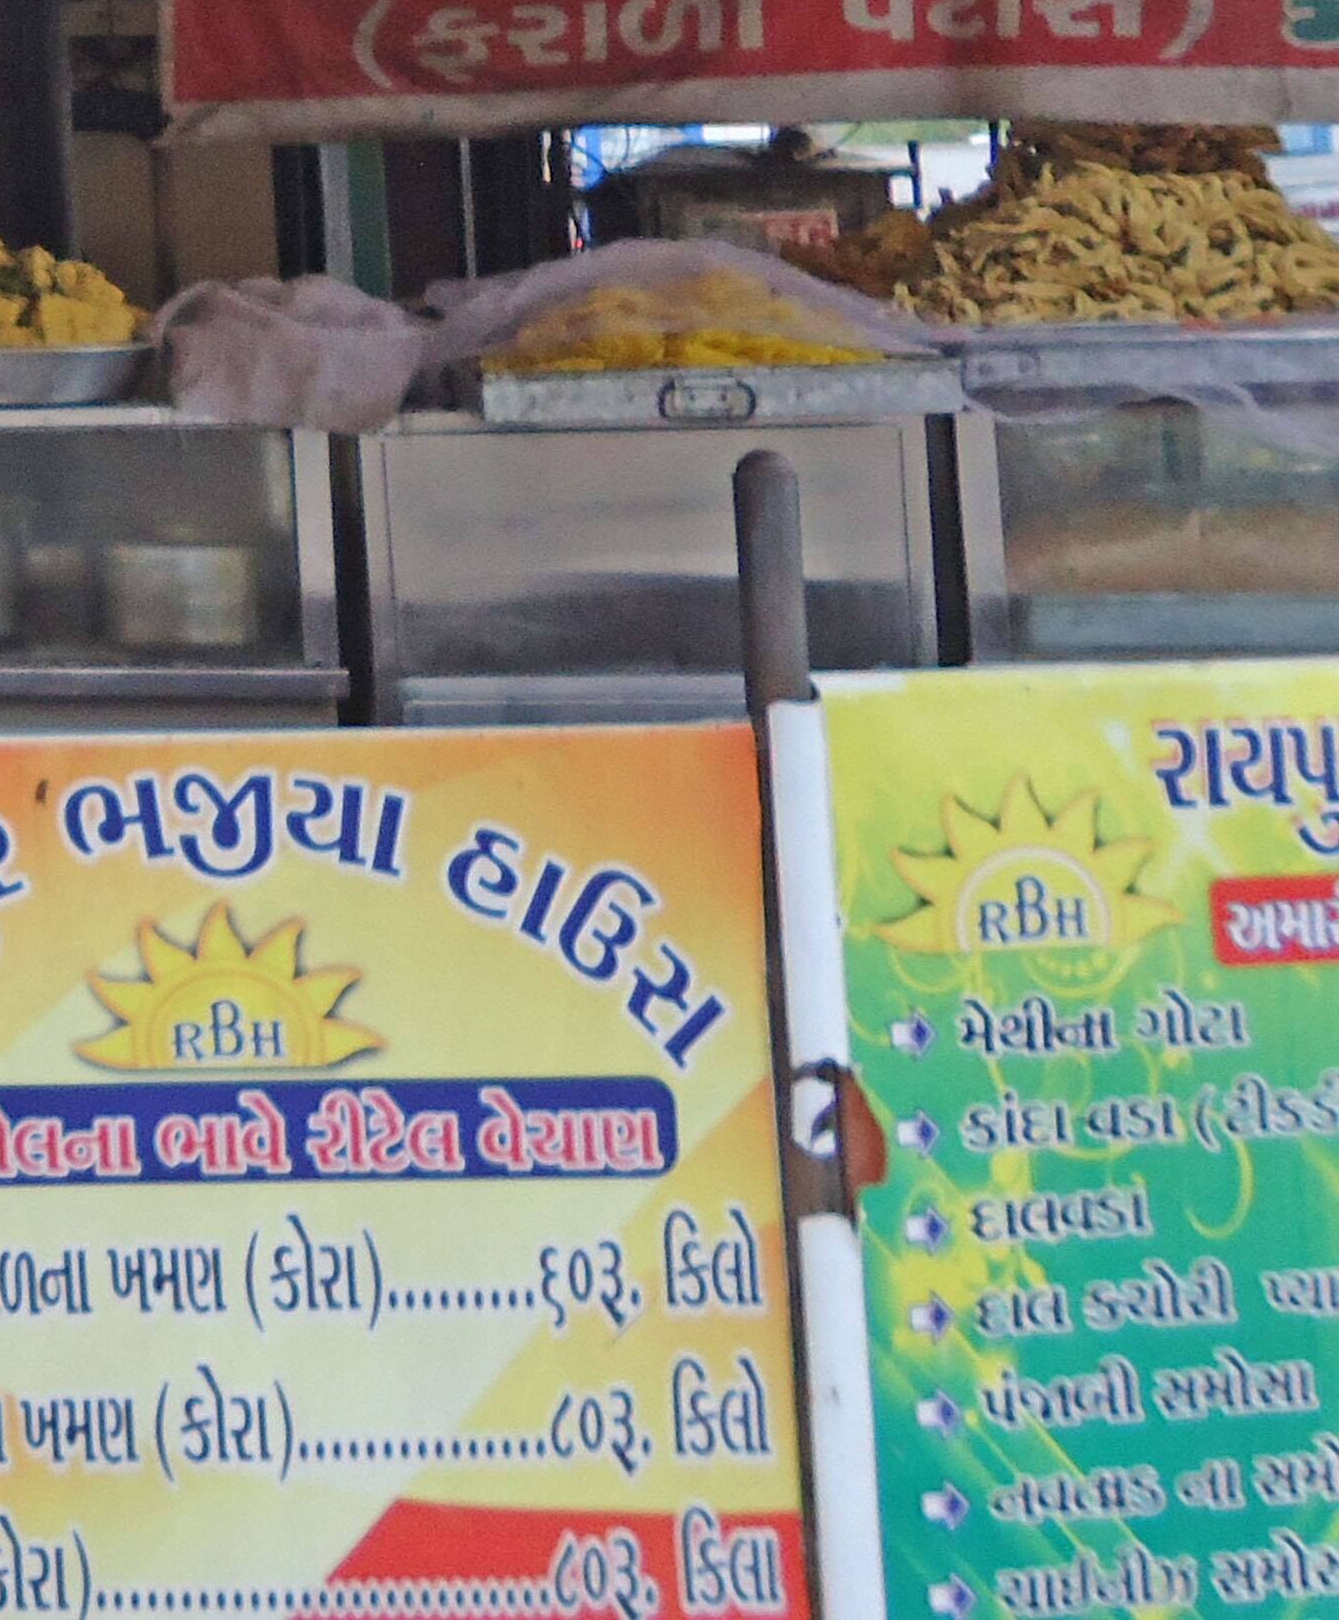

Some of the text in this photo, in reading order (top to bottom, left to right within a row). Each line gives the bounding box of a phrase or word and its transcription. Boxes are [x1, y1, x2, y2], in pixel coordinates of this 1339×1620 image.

[63, 771, 410, 879] ભજીયા
[445, 824, 727, 1068] હાઉસ
[979, 876, 1088, 943] RBH
[171, 1001, 287, 1063] RBH
[1137, 989, 1247, 1045] ગોટા
[154, 1093, 286, 1177] ભાવે
[305, 1088, 461, 1174] રીટેલ
[479, 1091, 663, 1172] વેચાણ
[107, 1244, 227, 1316] ખમણ
[664, 1209, 761, 1307] કિલો
[21, 1397, 139, 1465] ખમણ
[672, 1357, 771, 1455] કિલો
